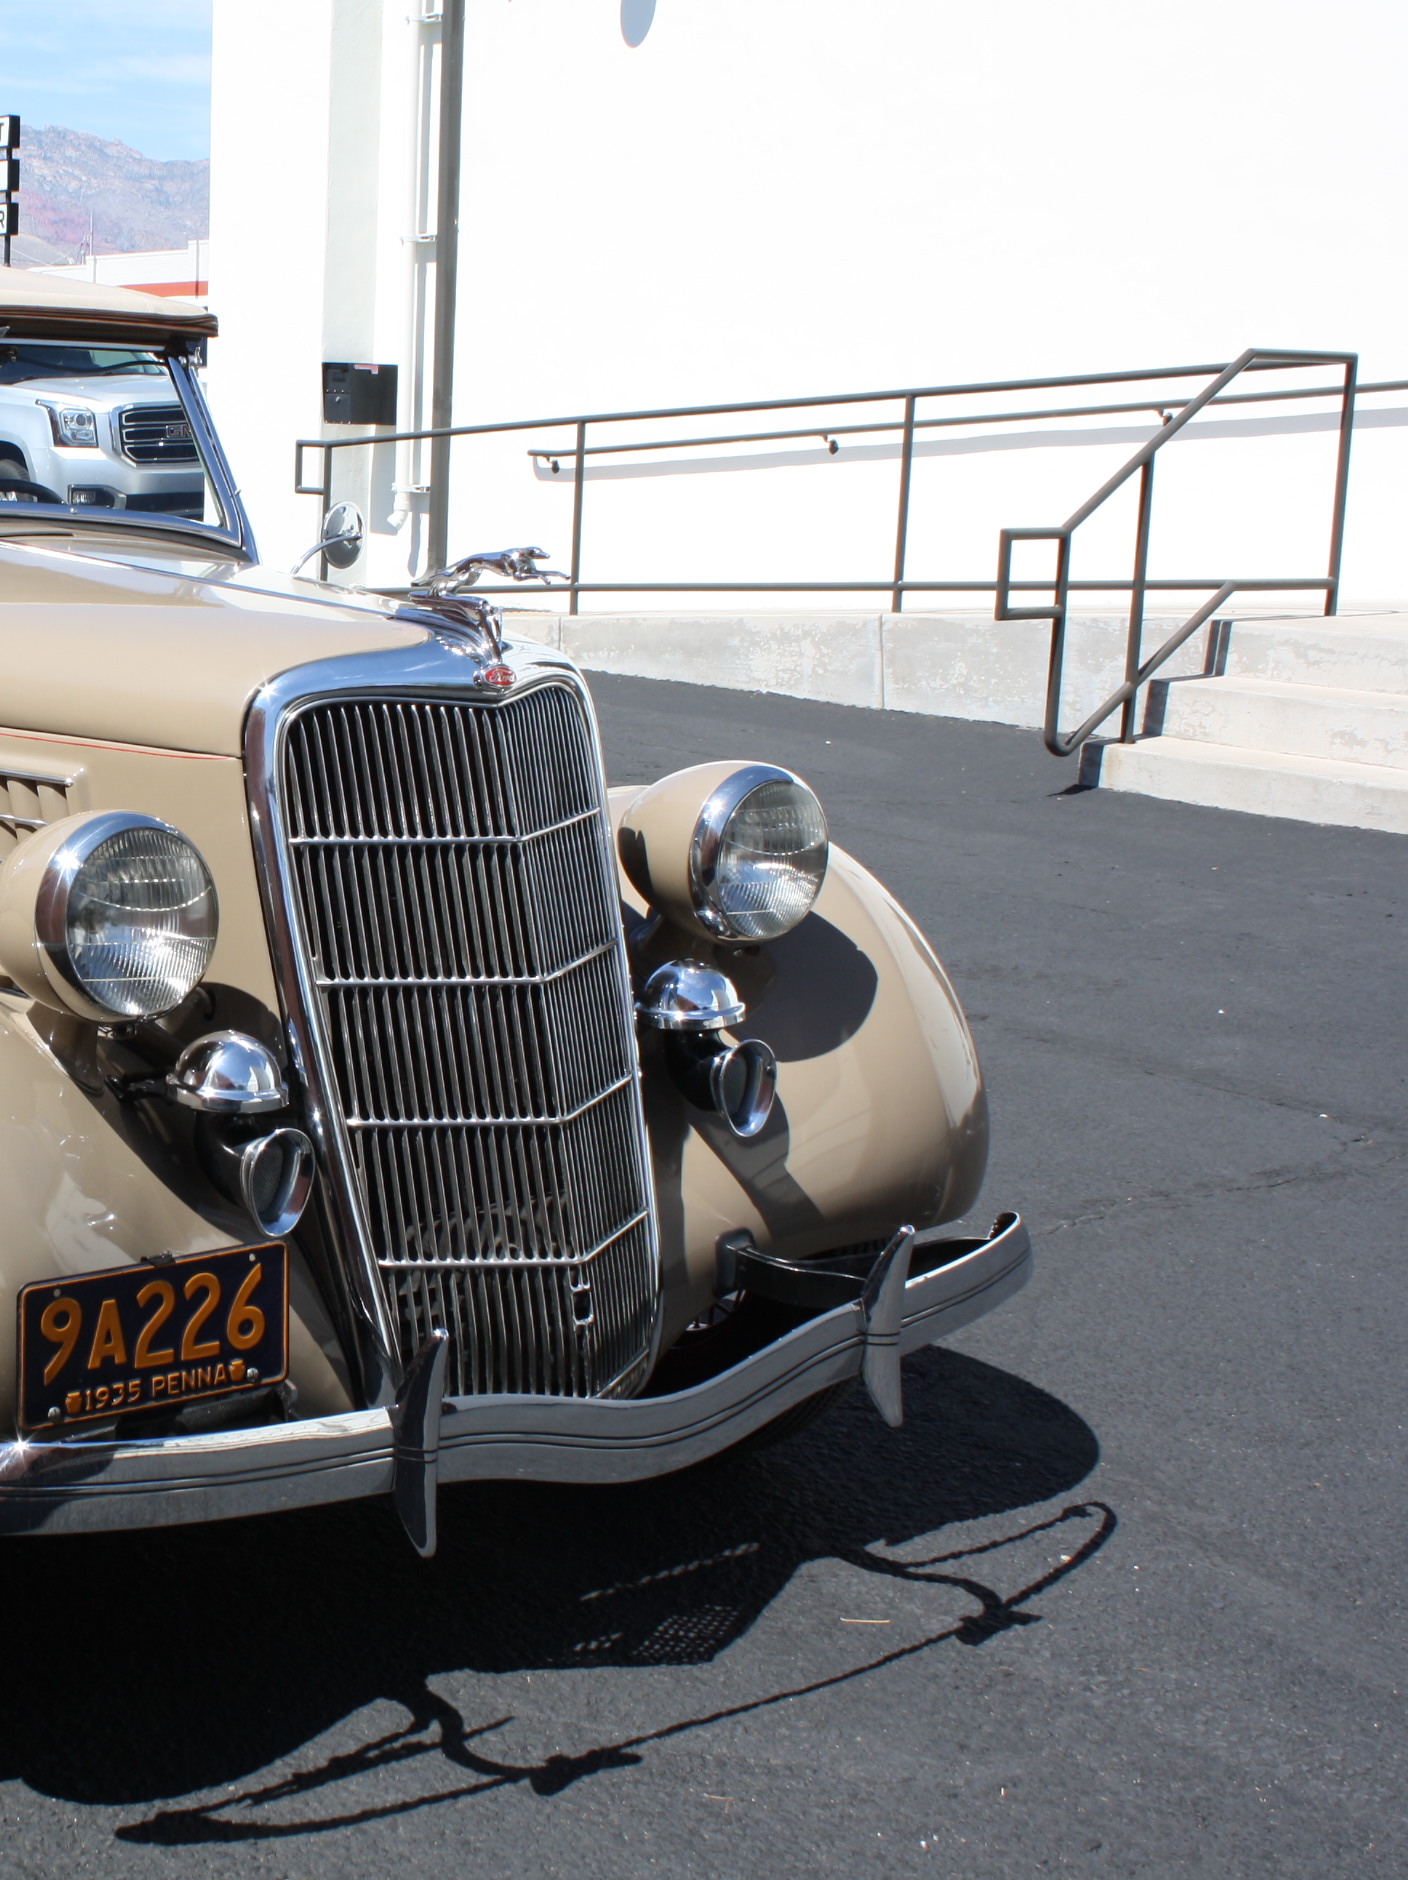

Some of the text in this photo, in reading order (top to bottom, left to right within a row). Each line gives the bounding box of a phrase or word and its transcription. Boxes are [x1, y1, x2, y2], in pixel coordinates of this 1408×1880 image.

[40, 1262, 266, 1387] 9A226
[84, 1363, 227, 1412] 1935 PENNA
